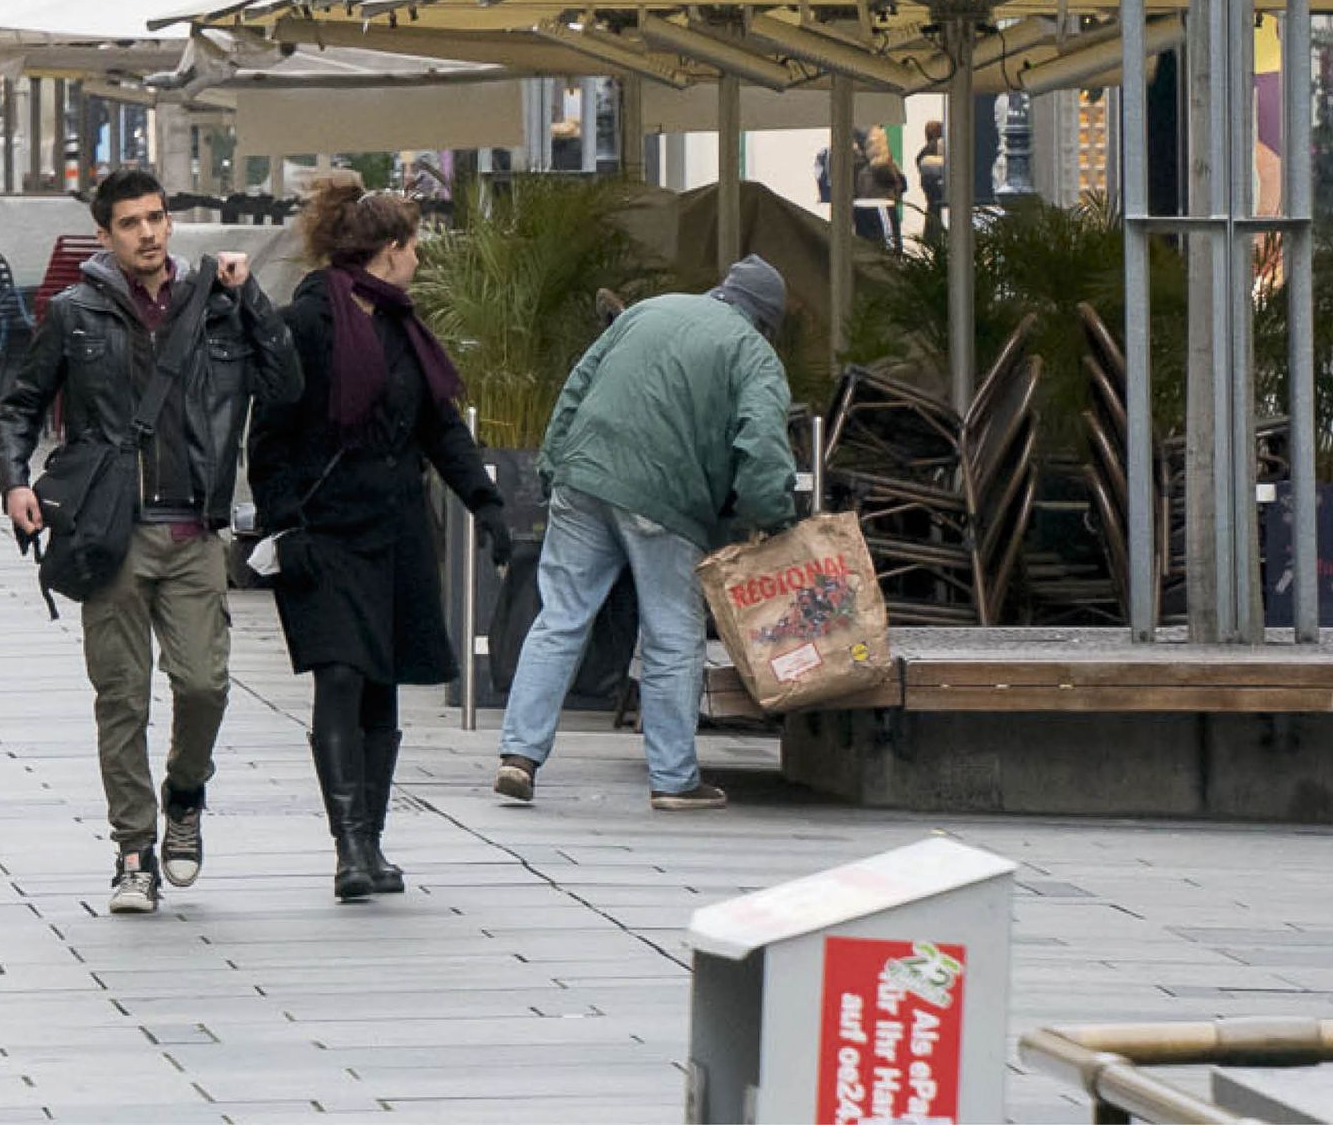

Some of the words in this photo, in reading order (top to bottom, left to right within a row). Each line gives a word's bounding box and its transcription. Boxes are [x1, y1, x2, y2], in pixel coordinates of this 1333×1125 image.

[729, 554, 853, 610] REGIONAL
[839, 992, 868, 1044] auf
[874, 1020, 904, 1062] Ihr
[909, 1007, 941, 1057] Als
